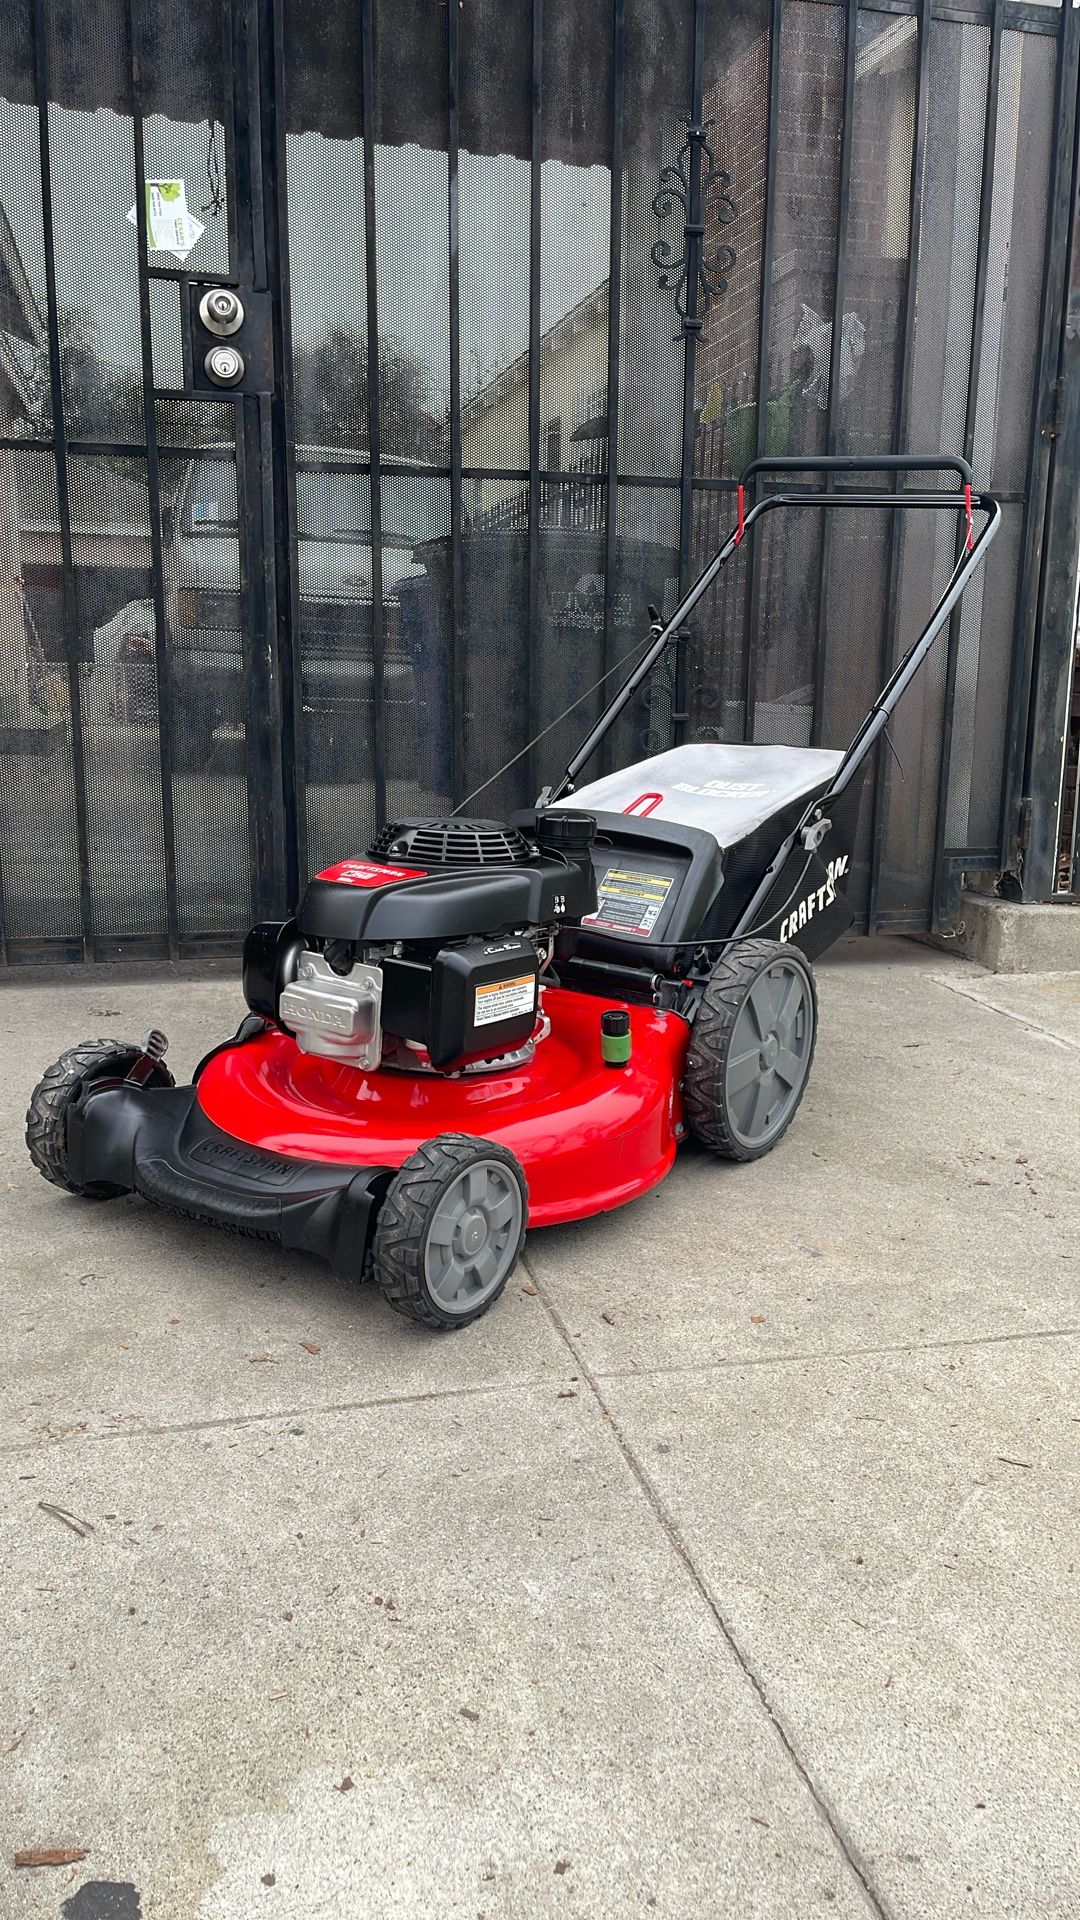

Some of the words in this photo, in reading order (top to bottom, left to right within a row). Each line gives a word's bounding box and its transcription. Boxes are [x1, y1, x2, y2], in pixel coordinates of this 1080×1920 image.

[672, 782, 771, 798] BLOCKER
[703, 780, 766, 791] DUST
[342, 863, 407, 877] CRAFTSMAN
[780, 855, 849, 943] CRAFTSAN
[283, 1002, 346, 1029] HONDA
[202, 1141, 293, 1176] CRAFTSMAN
